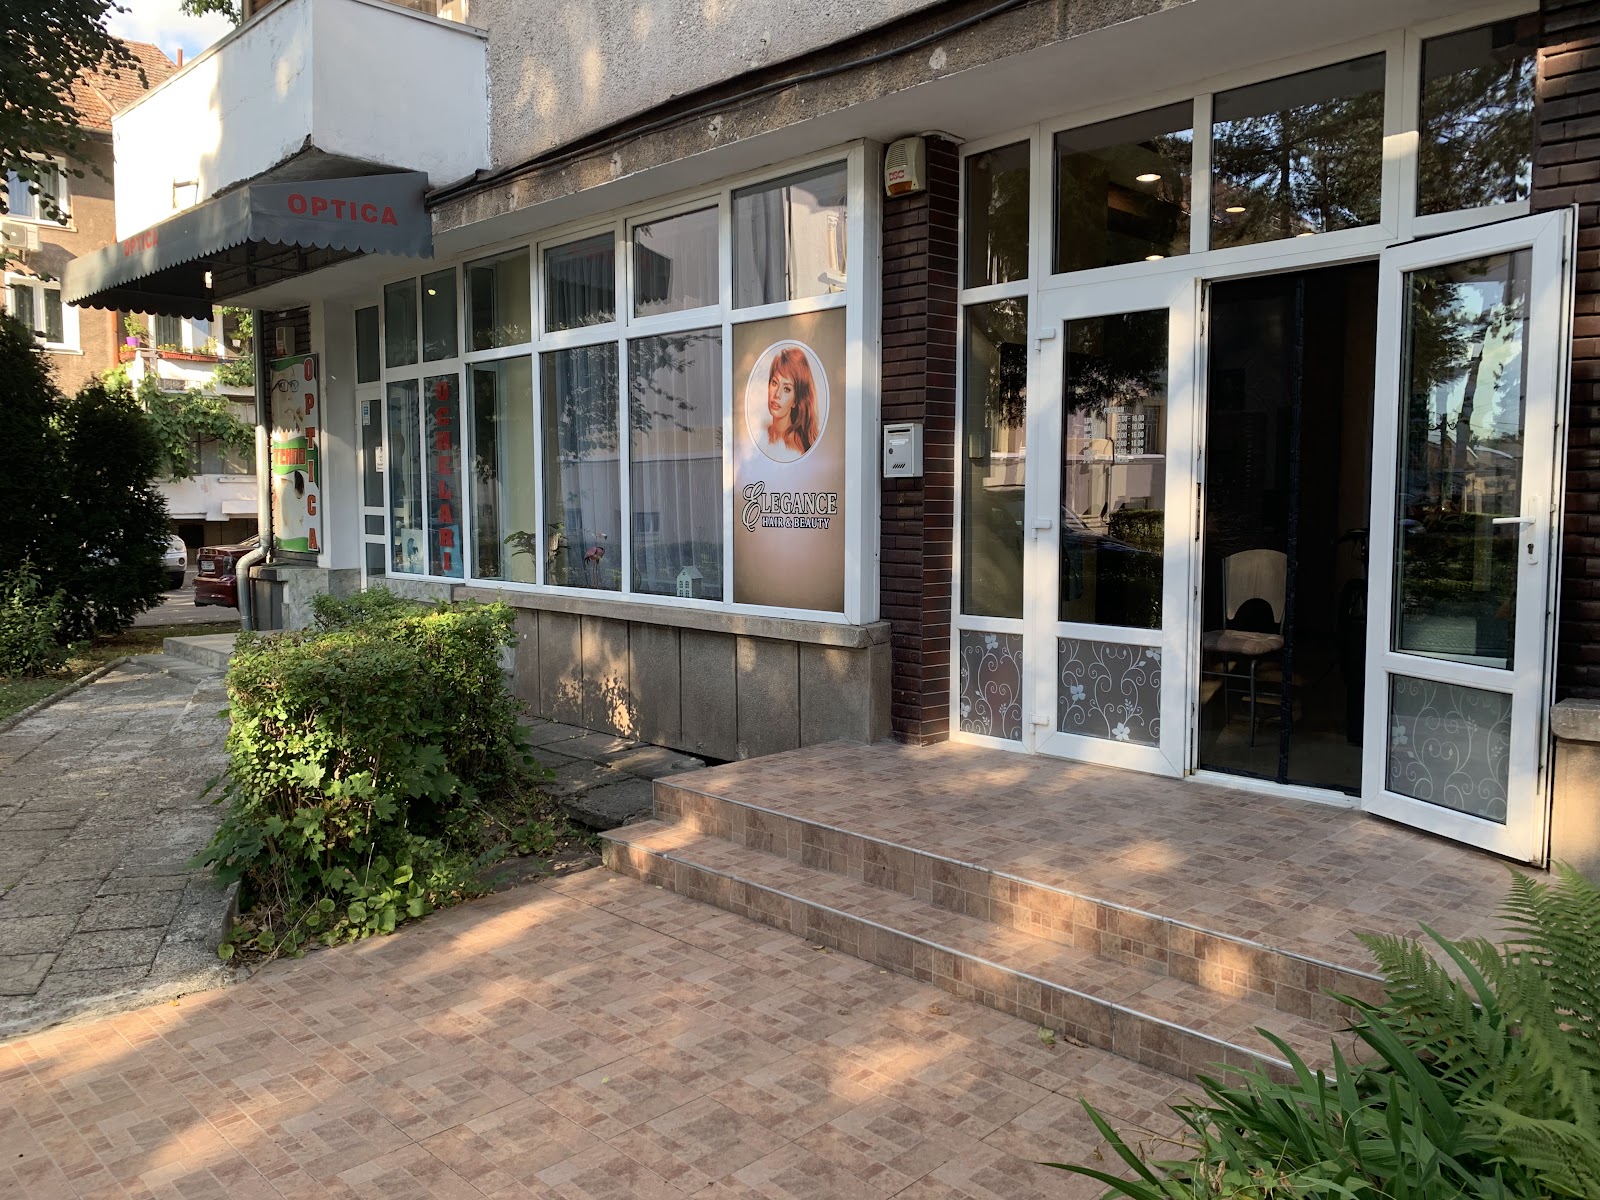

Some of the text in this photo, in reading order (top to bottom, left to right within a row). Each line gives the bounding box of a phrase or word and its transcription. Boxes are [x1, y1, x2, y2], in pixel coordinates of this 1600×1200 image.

[888, 169, 905, 181] DSC
[287, 193, 398, 225] OPTICA
[123, 228, 158, 257] OPTICA
[304, 358, 319, 549] OPTICA
[436, 381, 454, 570] OCHELARI
[742, 480, 838, 532] ELEGANCE
[762, 516, 830, 529] HAIR & BEAUTY
